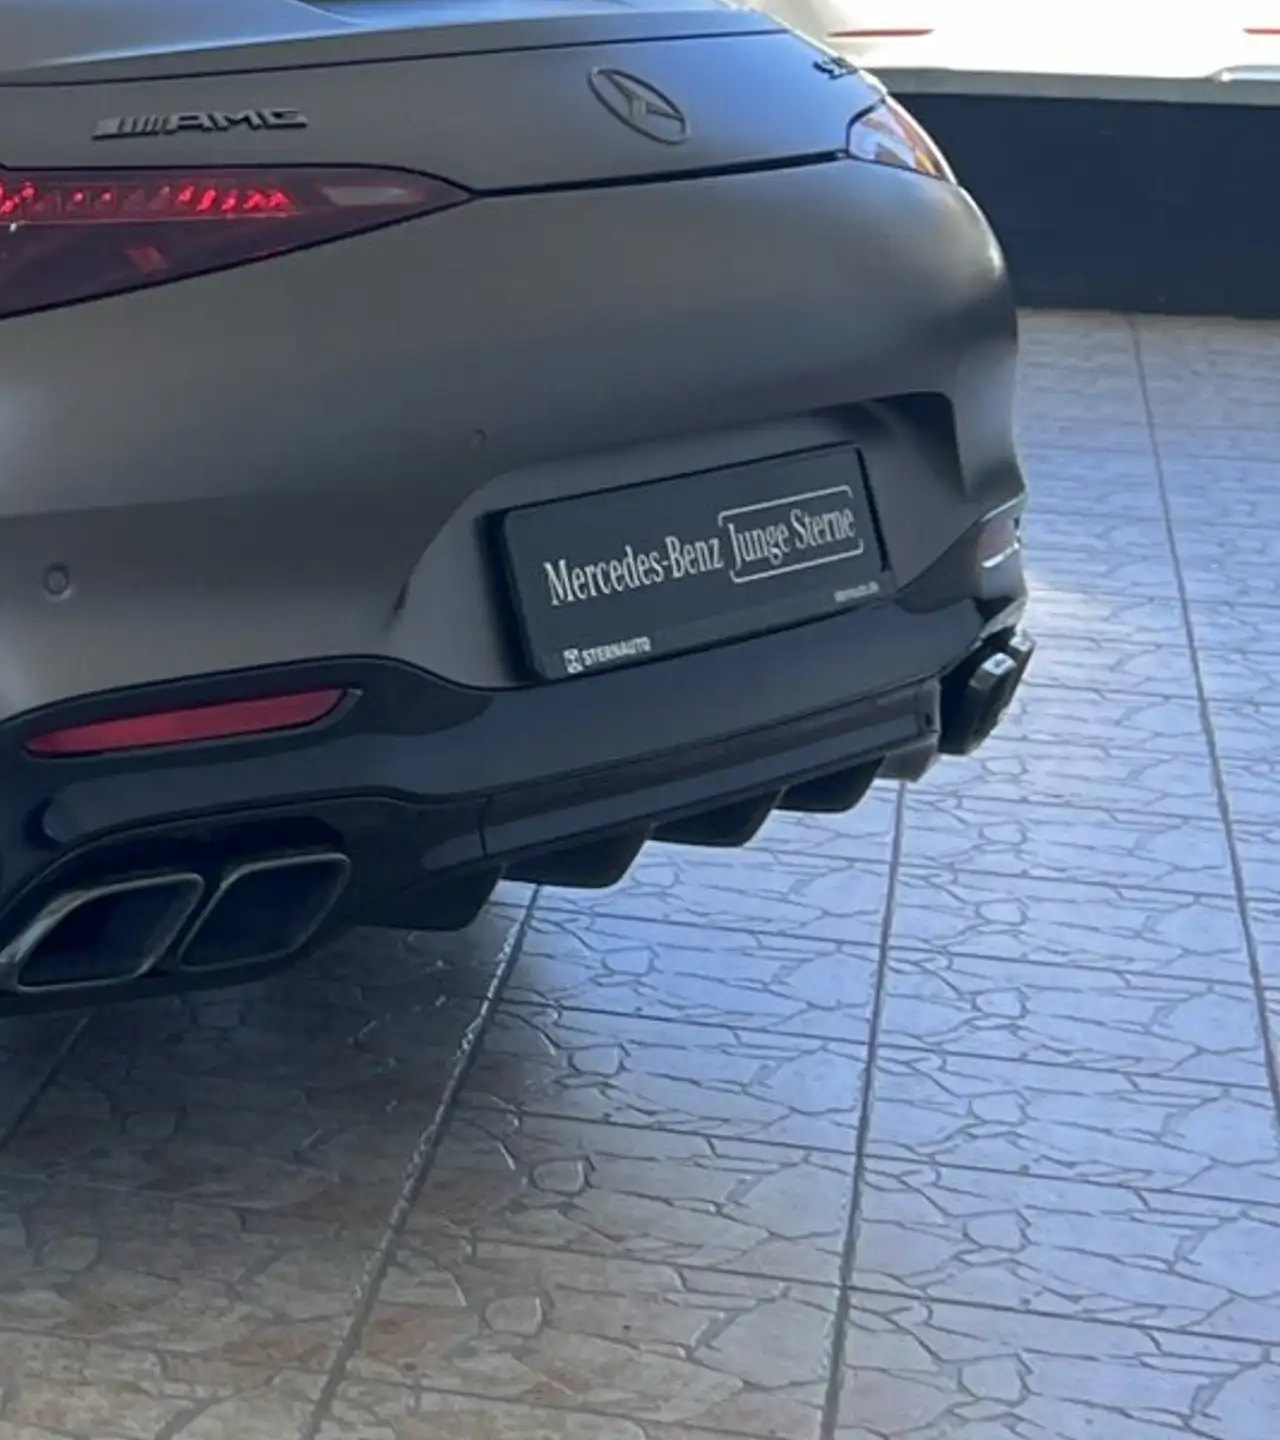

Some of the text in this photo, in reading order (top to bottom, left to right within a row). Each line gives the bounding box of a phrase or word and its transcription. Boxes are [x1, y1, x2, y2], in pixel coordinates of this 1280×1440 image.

[544, 507, 856, 606] Mercedes-Benz Junge Sterne
[581, 636, 653, 667] STERNAUTO
